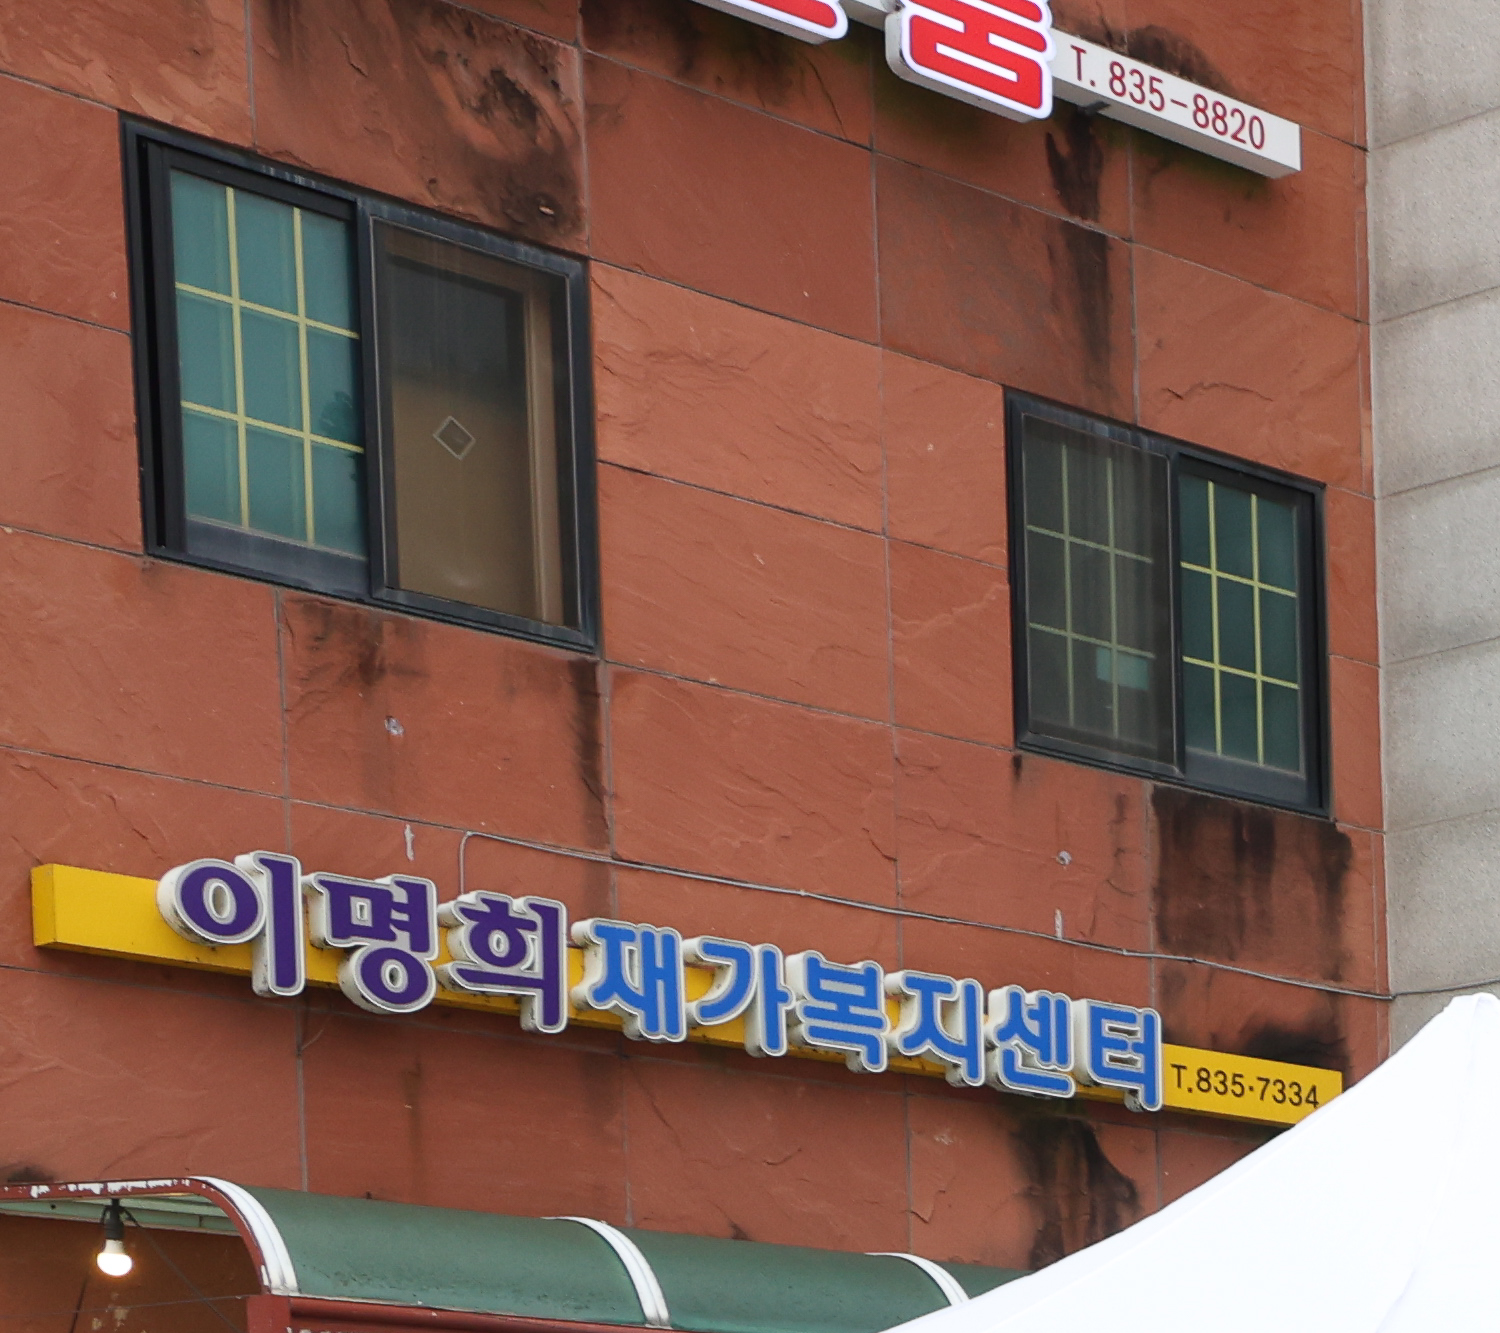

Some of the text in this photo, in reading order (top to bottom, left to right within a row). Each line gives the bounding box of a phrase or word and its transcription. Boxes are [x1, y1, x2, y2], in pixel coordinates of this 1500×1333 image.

[1109, 61, 1266, 150] 835-8820
[162, 851, 567, 1033] 이명희
[576, 919, 1163, 1111] 재가복지센터
